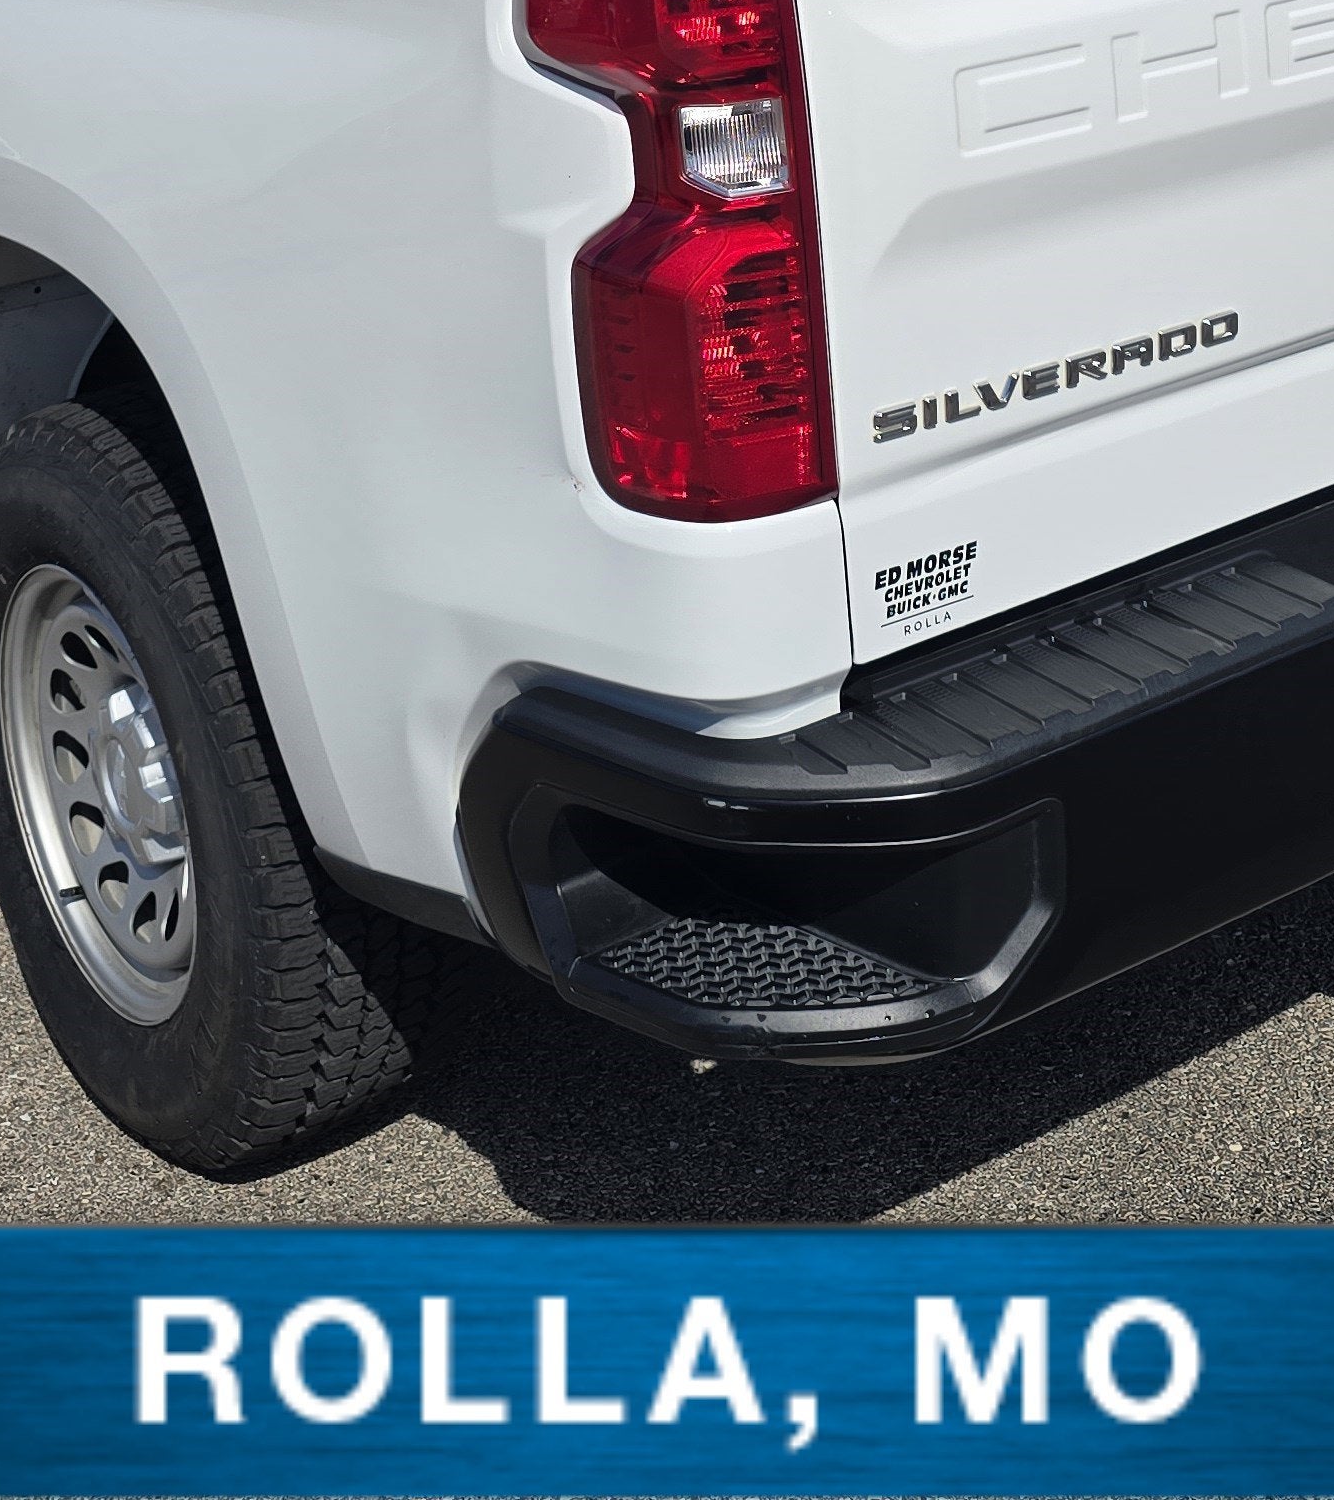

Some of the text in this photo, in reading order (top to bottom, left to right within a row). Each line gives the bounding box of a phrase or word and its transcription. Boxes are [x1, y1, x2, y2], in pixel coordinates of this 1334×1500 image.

[872, 308, 1240, 444] SILVERADO
[874, 540, 977, 591] ED MORSE
[884, 562, 972, 603] CHEVROLET
[903, 610, 952, 637] ROLLA
